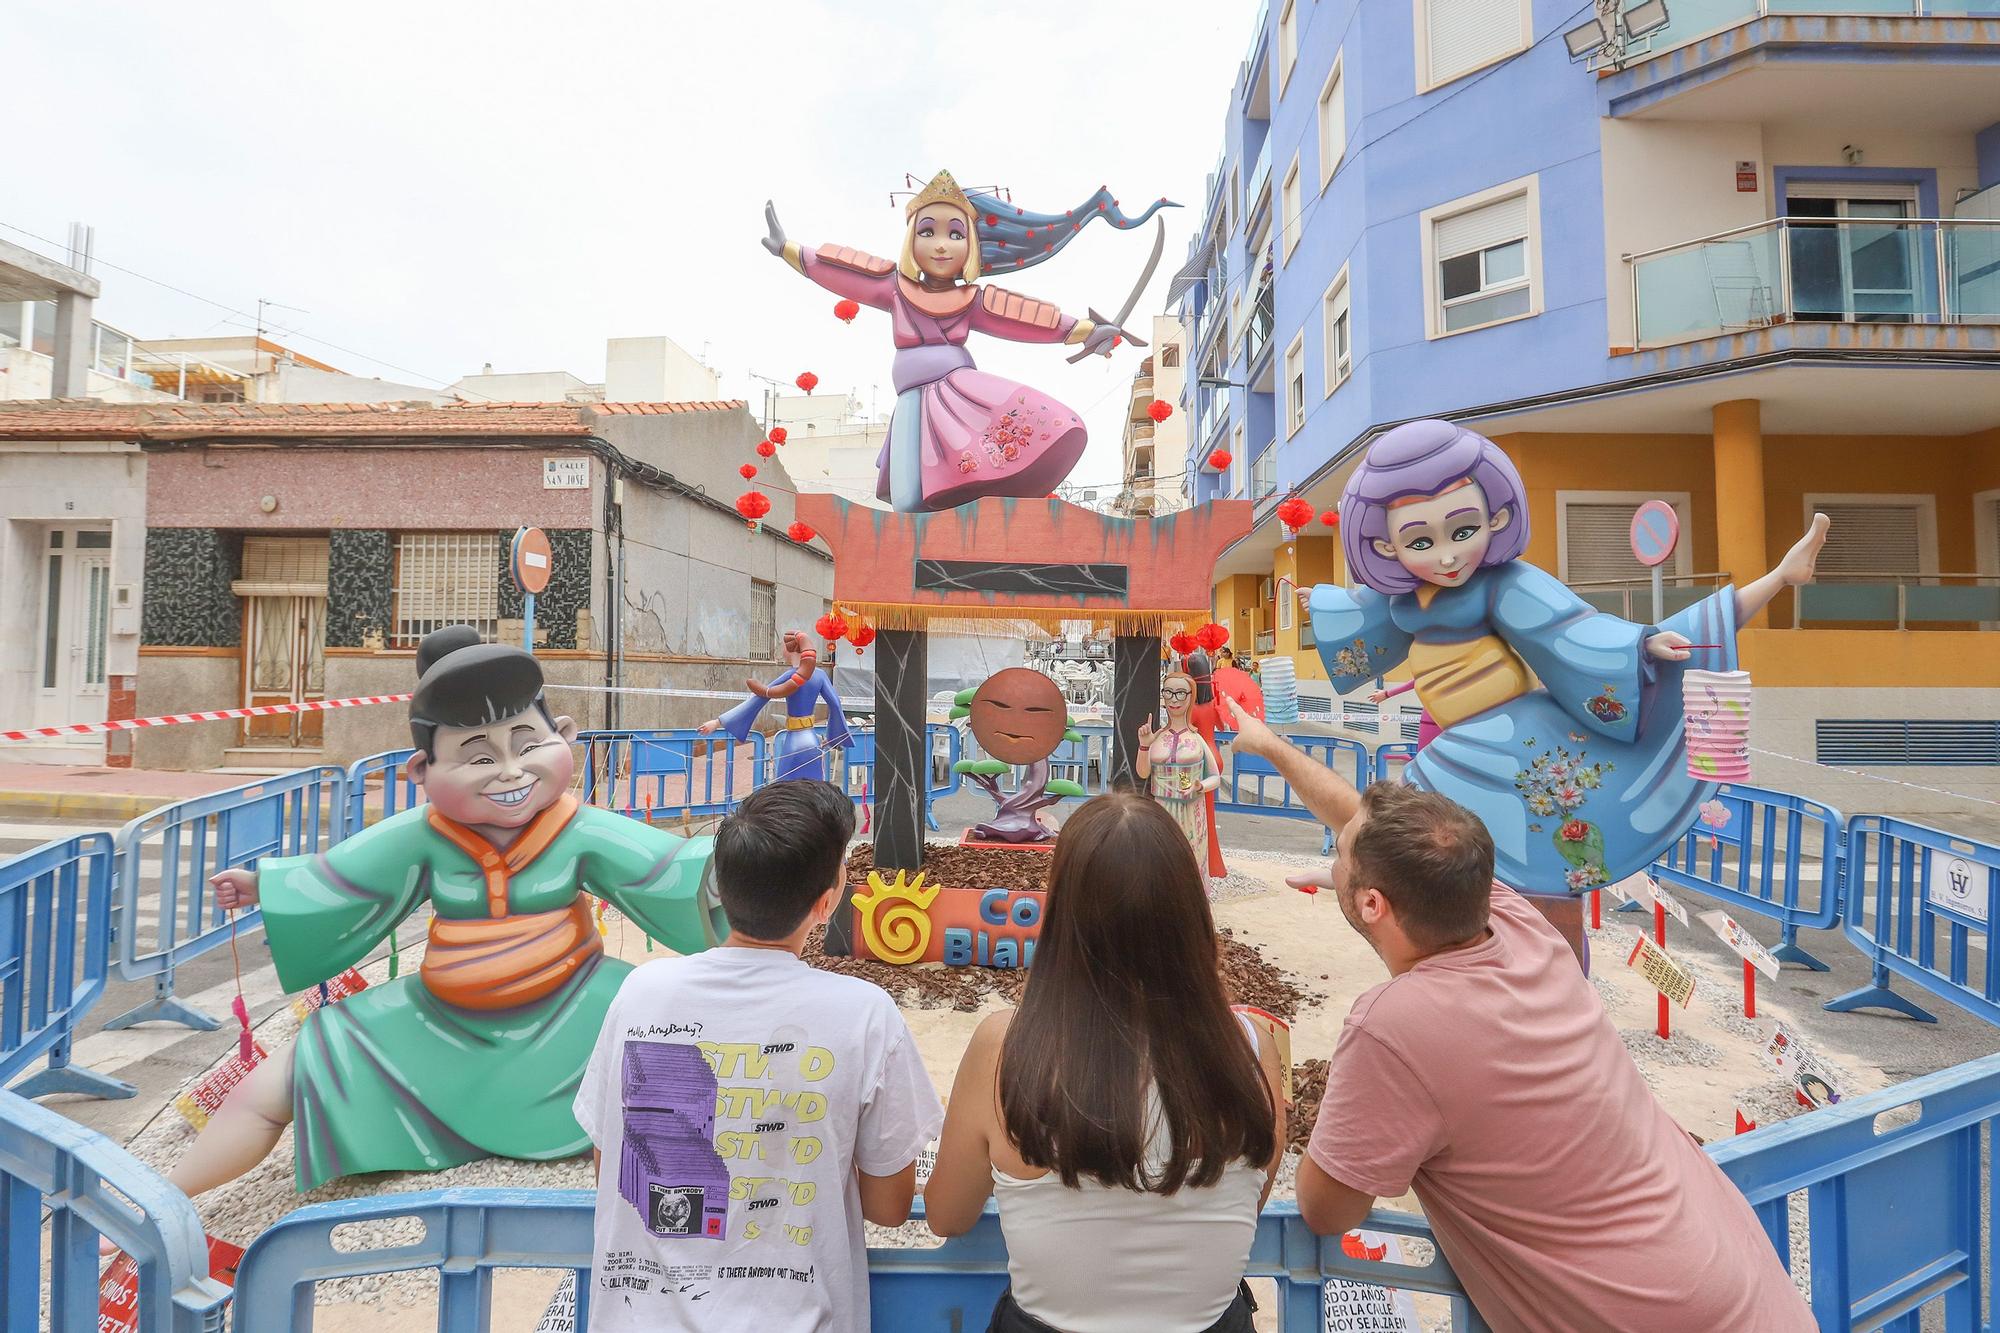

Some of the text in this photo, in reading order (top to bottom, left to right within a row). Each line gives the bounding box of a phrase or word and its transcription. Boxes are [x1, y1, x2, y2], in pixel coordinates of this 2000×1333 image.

[547, 474, 561, 485] SAN
[763, 1043, 795, 1054] STWD
[754, 1123, 785, 1133] STWD
[748, 1198, 779, 1211] STWD
[727, 1267, 747, 1278] THERE
[748, 1267, 776, 1278] ANYBODY
[777, 1268, 788, 1278] OUT
[1351, 1290, 1359, 1301] 2
[1350, 1303, 1365, 1315] LA
[1366, 1303, 1393, 1315] CALLE
[1327, 1319, 1353, 1332] HOY
[1357, 1318, 1370, 1329] SE
